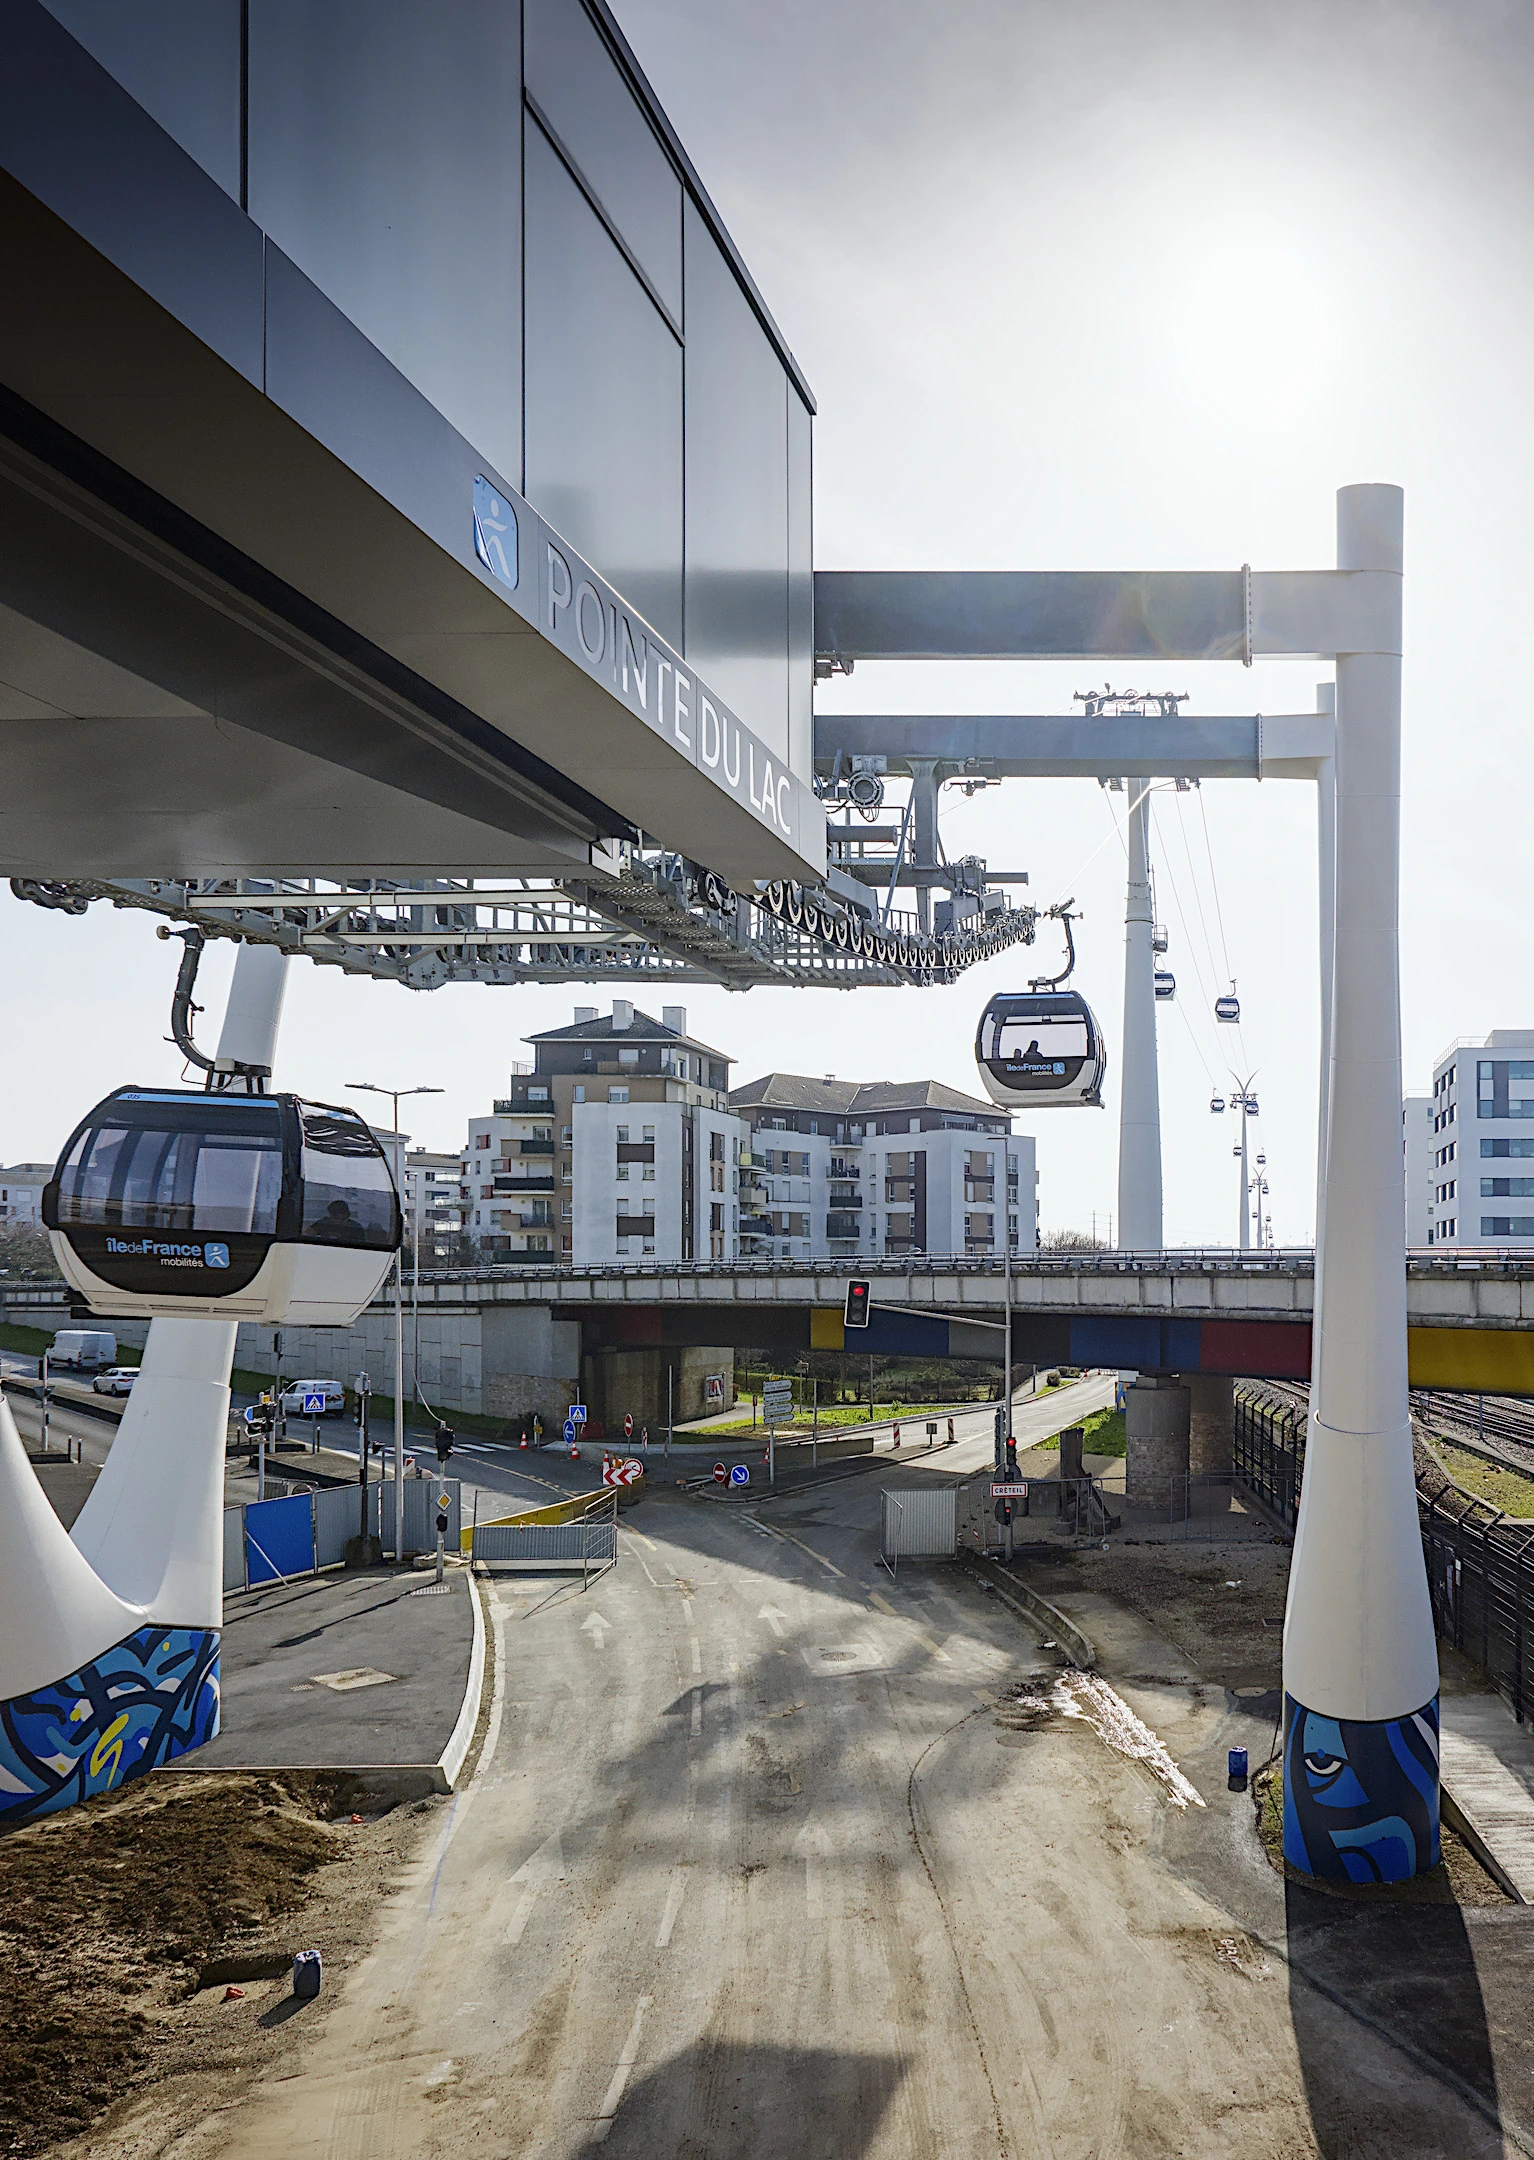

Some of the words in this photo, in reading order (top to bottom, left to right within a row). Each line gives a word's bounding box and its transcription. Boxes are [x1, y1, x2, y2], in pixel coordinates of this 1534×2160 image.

[547, 541, 691, 750] POINTE
[701, 695, 740, 789] DU
[749, 742, 791, 836] LAC
[160, 1257, 204, 1268] mobilités
[994, 1486, 1023, 1494] CRÉTEIL
